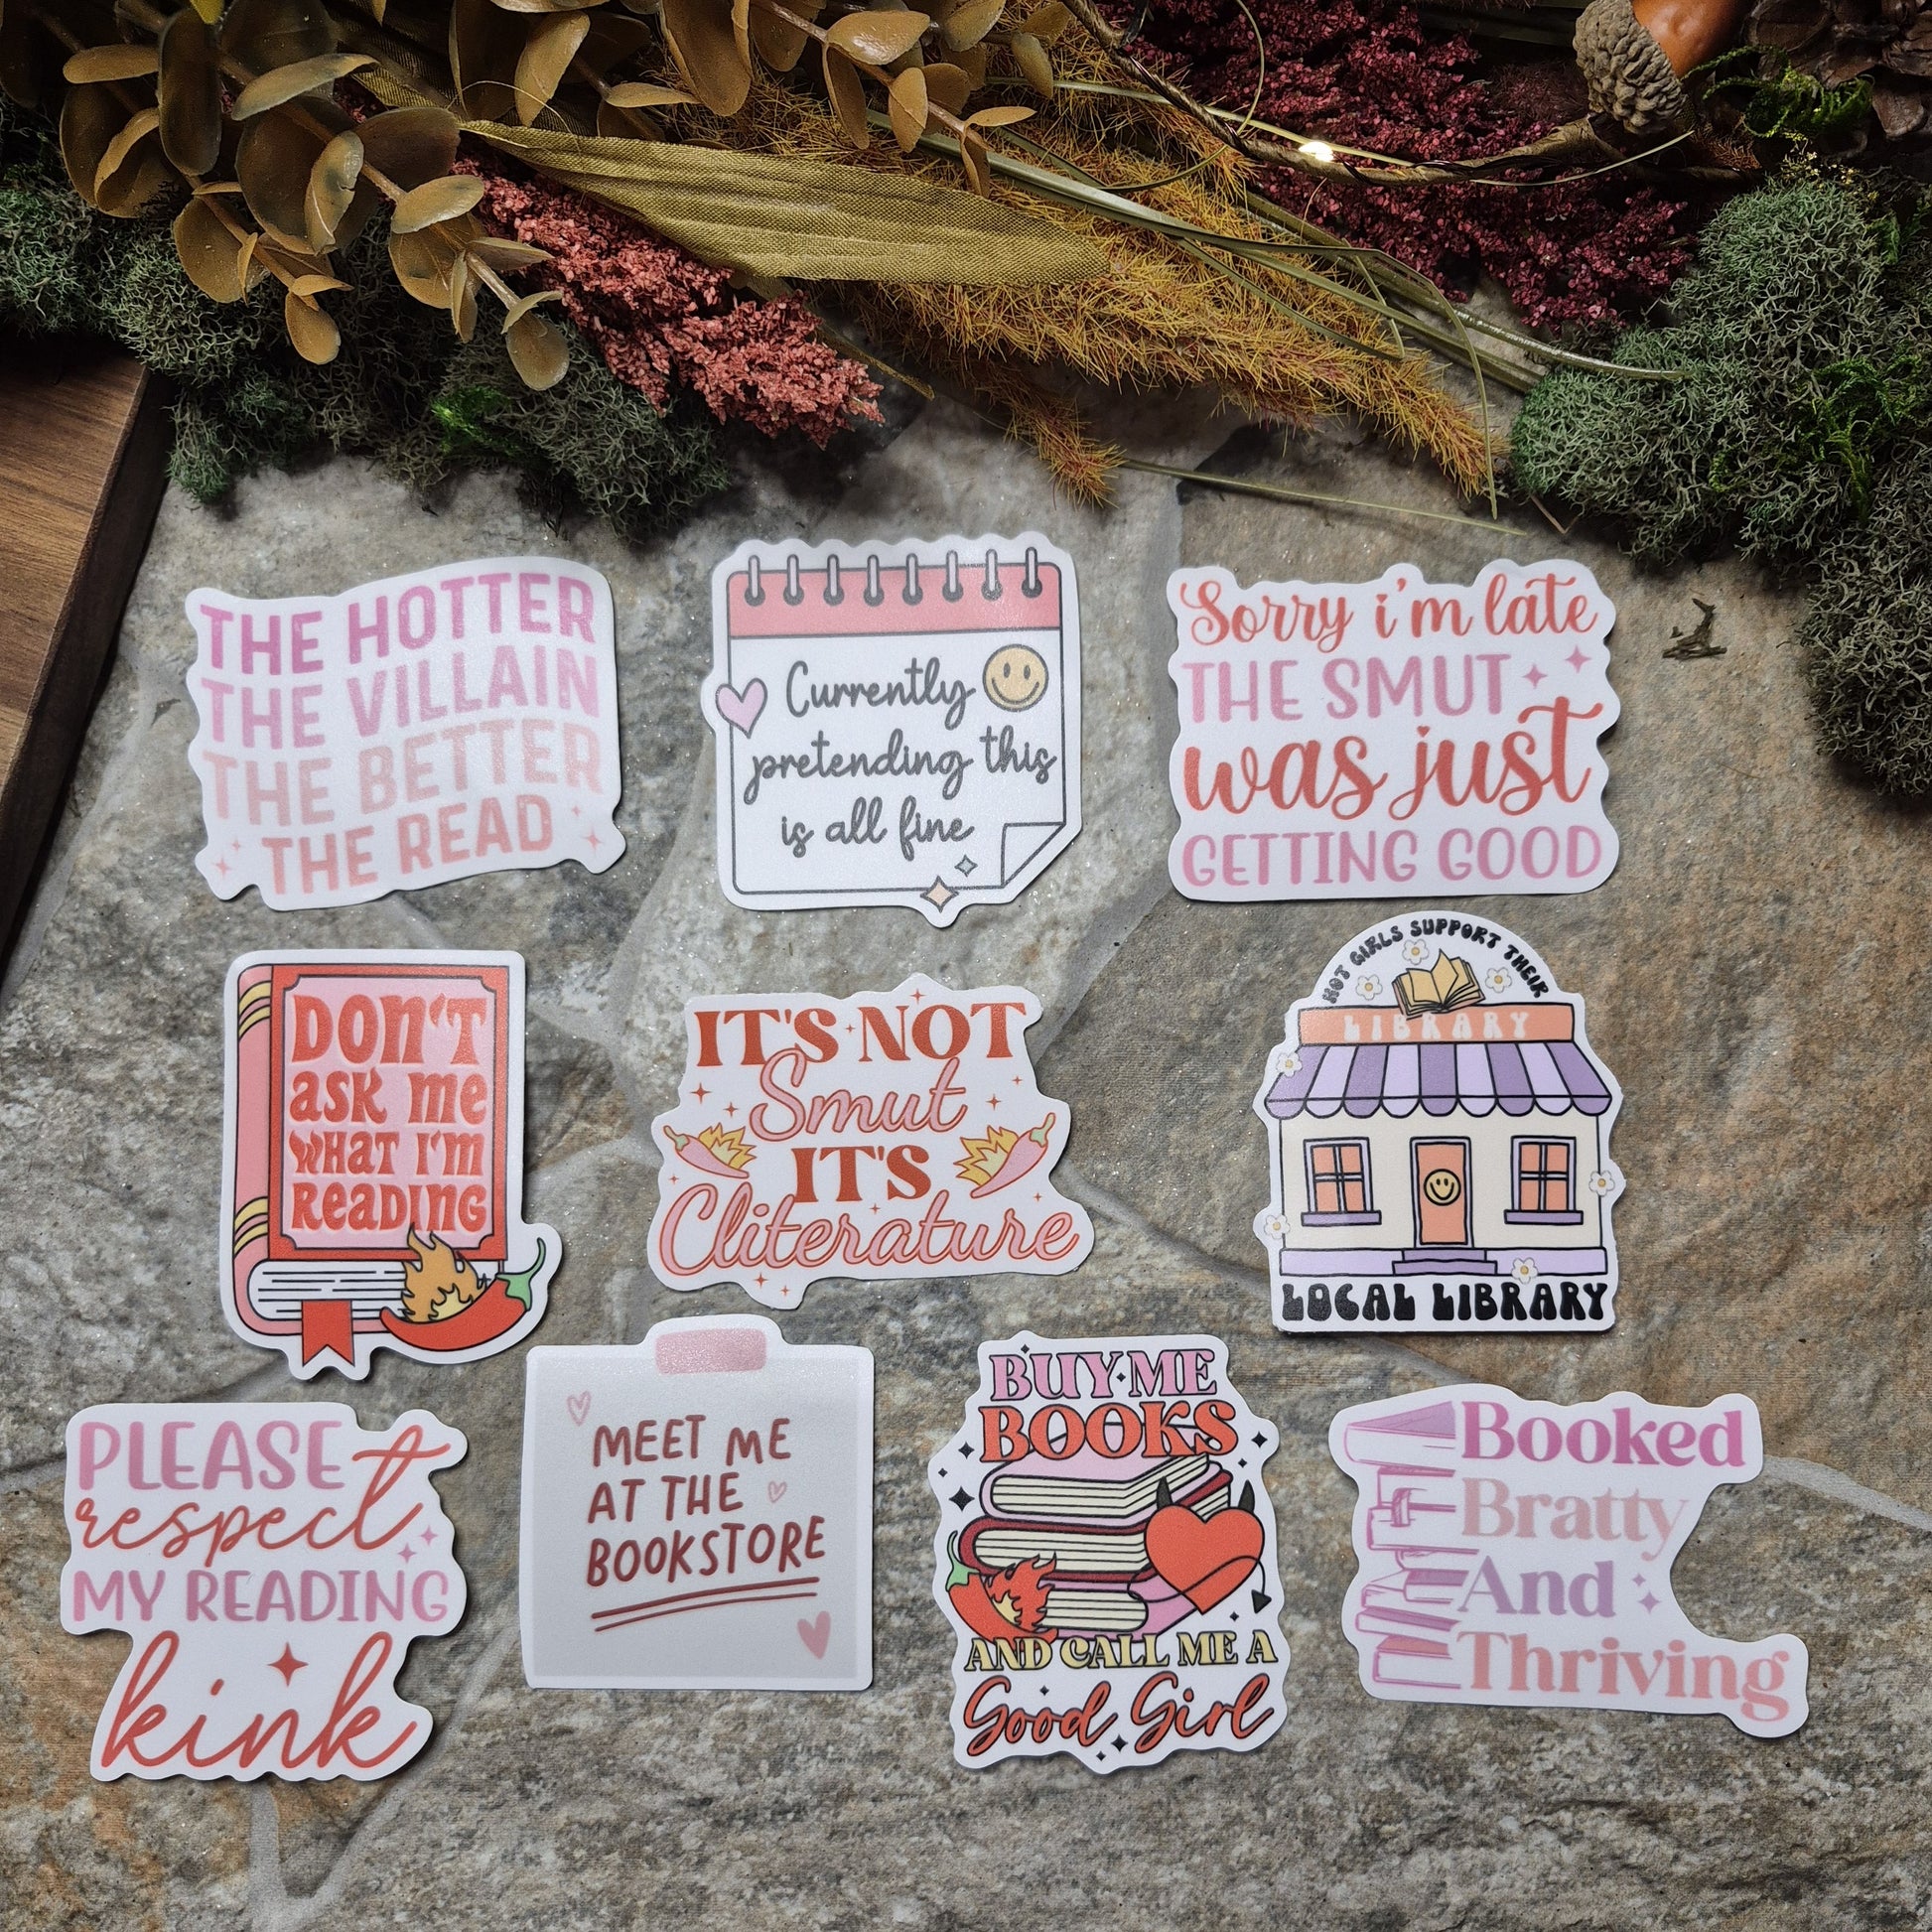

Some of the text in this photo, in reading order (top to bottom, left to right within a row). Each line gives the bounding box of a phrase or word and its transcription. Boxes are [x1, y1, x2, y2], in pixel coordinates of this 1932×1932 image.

[200, 572, 596, 675] THE HOTTER
[1179, 573, 1597, 653] Sorry i'm late
[202, 644, 600, 750] THE VILLAIN
[786, 657, 976, 730] Currently
[1181, 653, 1511, 723] THE SMUT
[203, 719, 604, 826] THE BETTER
[744, 725, 1057, 805] pretending this
[1183, 696, 1603, 820] was just
[261, 794, 553, 895] THE READ
[781, 795, 974, 861] is all fine
[1182, 825, 1601, 887] GETTING GOOD
[1321, 918, 1550, 1004] HOT GIRLS SUPPORT THEIR
[694, 1002, 1027, 1067] IT'S NOT
[1343, 1012, 1529, 1041] LIBRARY
[749, 1046, 968, 1142] Smut
[790, 1144, 930, 1203] IT'S
[659, 1181, 1080, 1276] Cliterature
[1282, 1282, 1608, 1320] LOCAL LIBRARY
[989, 1347, 1217, 1402] BUY ME
[78, 1420, 345, 1490] PLEASE
[593, 1414, 791, 1467] MEET ME
[979, 1401, 1238, 1463] BOOKS
[1461, 1401, 1745, 1466] Booked
[74, 1425, 452, 1568] respect
[587, 1471, 745, 1524] AT THE
[1461, 1477, 1690, 1562] Bratty
[586, 1515, 826, 1587] BOOKSTORE
[1456, 1556, 1616, 1617] And
[72, 1570, 450, 1622] MY READING
[964, 1630, 1278, 1672] AND CALL ME A
[1455, 1630, 1790, 1722] Thriving
[100, 1630, 418, 1769] kink
[963, 1672, 1274, 1757] Good Girl
